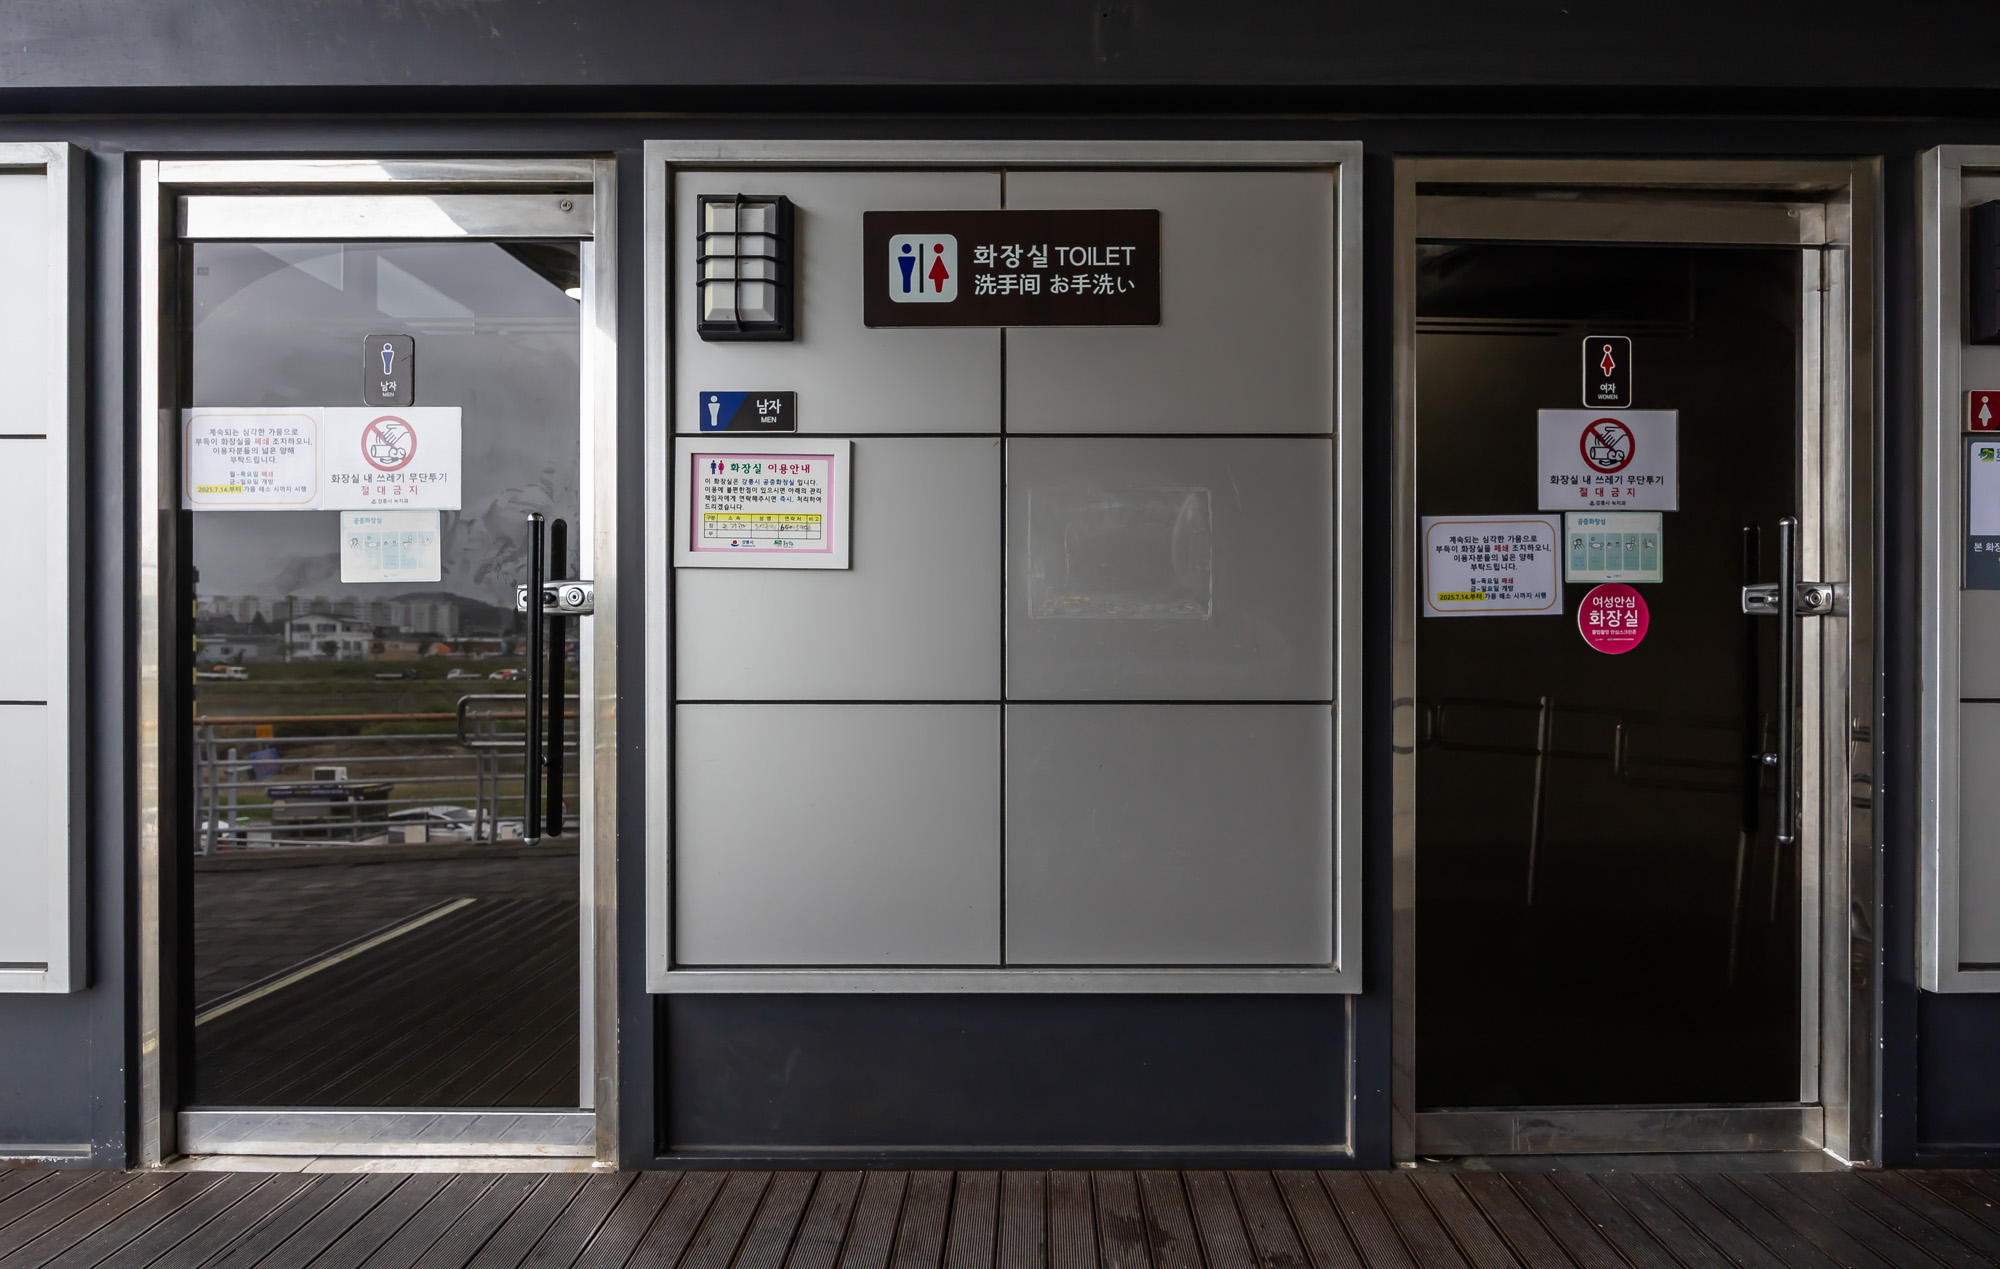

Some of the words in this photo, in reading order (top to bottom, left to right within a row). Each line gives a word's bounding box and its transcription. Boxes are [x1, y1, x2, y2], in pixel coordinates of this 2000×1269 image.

[973, 244, 1048, 268] 화장실
[1054, 246, 1136, 266] TOILET
[974, 274, 1040, 295] 洗手间
[1050, 273, 1136, 295] お手洗い
[380, 381, 396, 391] 남자
[1600, 383, 1616, 393] 여자
[756, 399, 781, 414] 남자
[730, 463, 761, 474] 화장실
[768, 463, 810, 474] 이용안내
[331, 473, 360, 483] 화장실
[364, 473, 372, 483] 내
[377, 473, 404, 483] 쓰레기
[409, 473, 447, 483] 무단투기
[1550, 475, 1578, 485] 화장실
[1582, 475, 1591, 485] 내
[1595, 475, 1623, 485] 쓰레기
[1627, 475, 1664, 485] 무단투기
[1974, 543, 1982, 552] 본
[1593, 596, 1635, 608] 여성안심
[1589, 610, 1638, 627] 화장실
